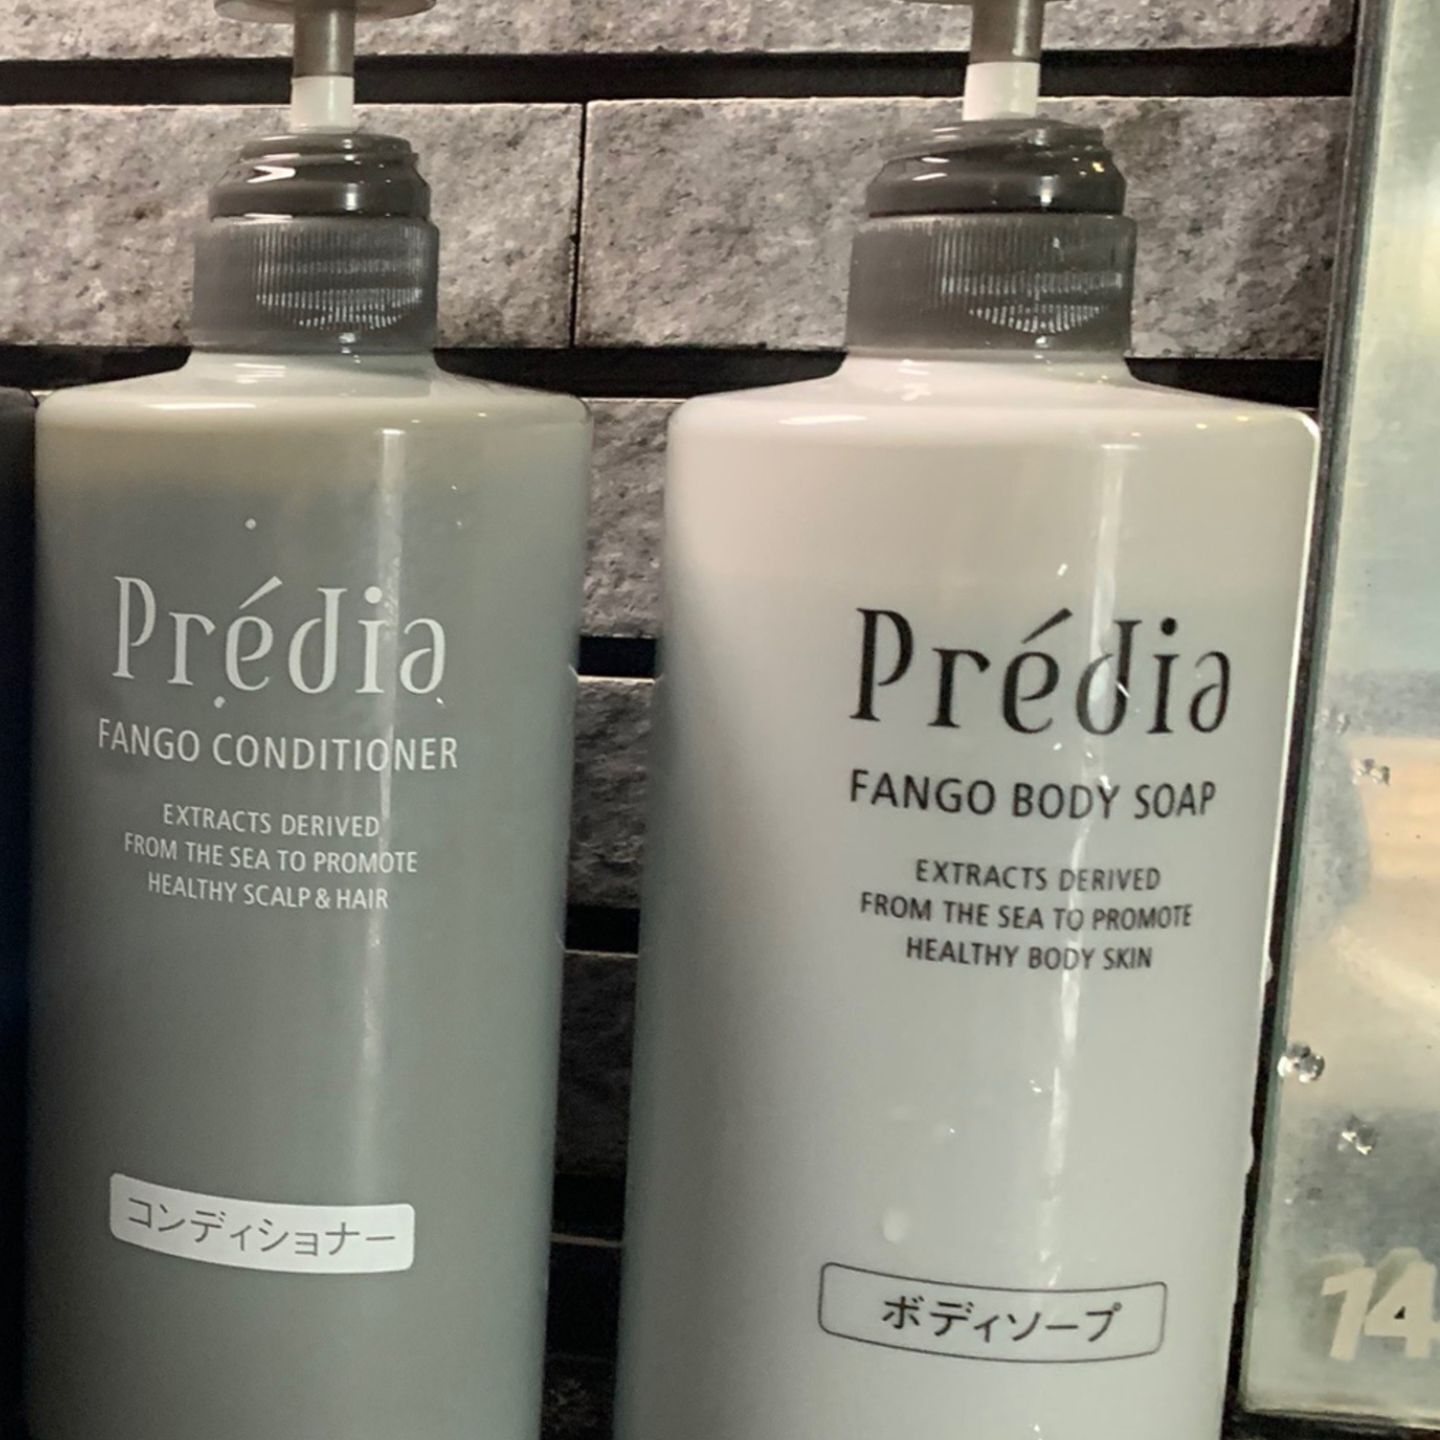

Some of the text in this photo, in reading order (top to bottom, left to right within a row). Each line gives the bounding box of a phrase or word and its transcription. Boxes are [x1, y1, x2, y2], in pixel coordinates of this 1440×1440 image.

[112, 575, 445, 694] Prédia
[849, 608, 1230, 735] Prédia
[99, 718, 458, 771] FANGO CONDITIONER
[850, 769, 1216, 819] FANGO BODY SOAP
[163, 804, 379, 837] EXTRACTS DERIVED
[124, 832, 418, 873] FROM THE SEA TO PROMOTE
[916, 859, 1160, 892] EXTRACTS DERIVED
[148, 872, 388, 909] HEALTHY SCALP & HAIR
[861, 892, 1193, 931] FROM THE SEA TO PROMOTE
[907, 937, 1152, 970] HEALTHY BODY SKIN
[129, 1197, 395, 1256] コンディショナー
[883, 1296, 1122, 1342] ボディソープ
[1320, 1262, 1440, 1361] 14
